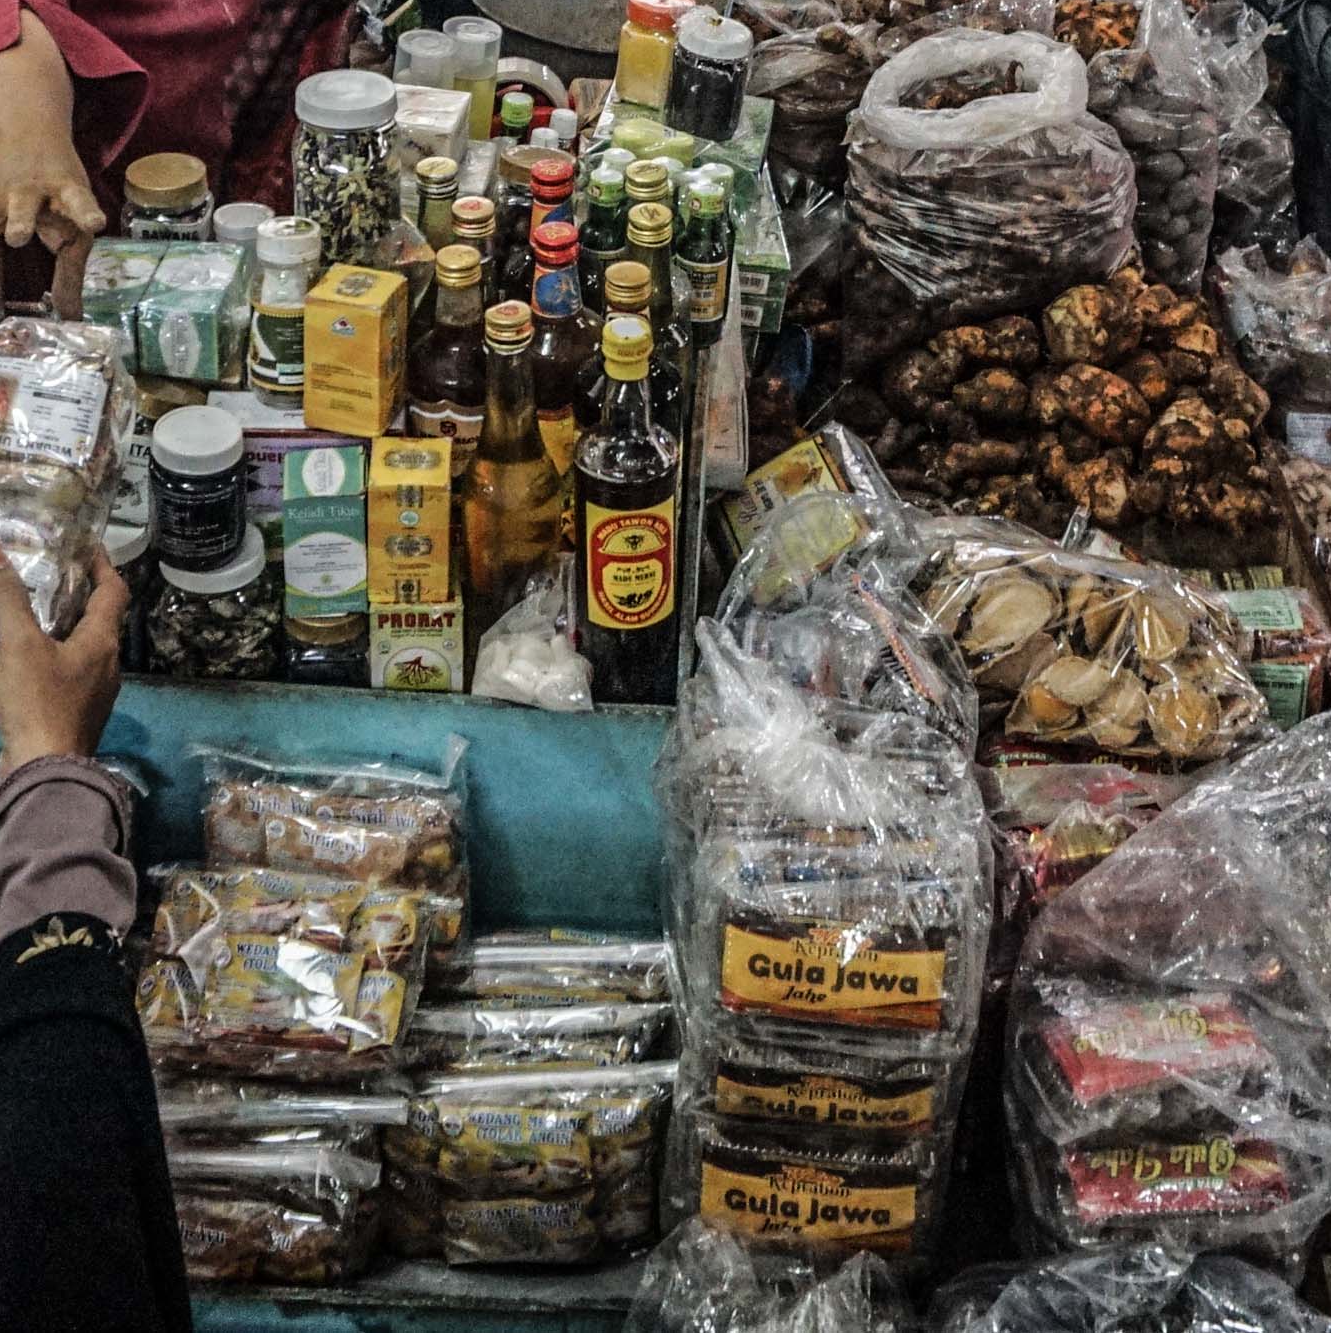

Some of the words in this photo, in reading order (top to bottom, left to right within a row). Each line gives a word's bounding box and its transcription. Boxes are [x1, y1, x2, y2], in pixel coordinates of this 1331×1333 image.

[747, 953, 825, 986] Gula
[829, 961, 919, 996] Jawa
[780, 984, 827, 1004] Jahe
[469, 1113, 521, 1127] WEDANG
[724, 1188, 800, 1218] Gula
